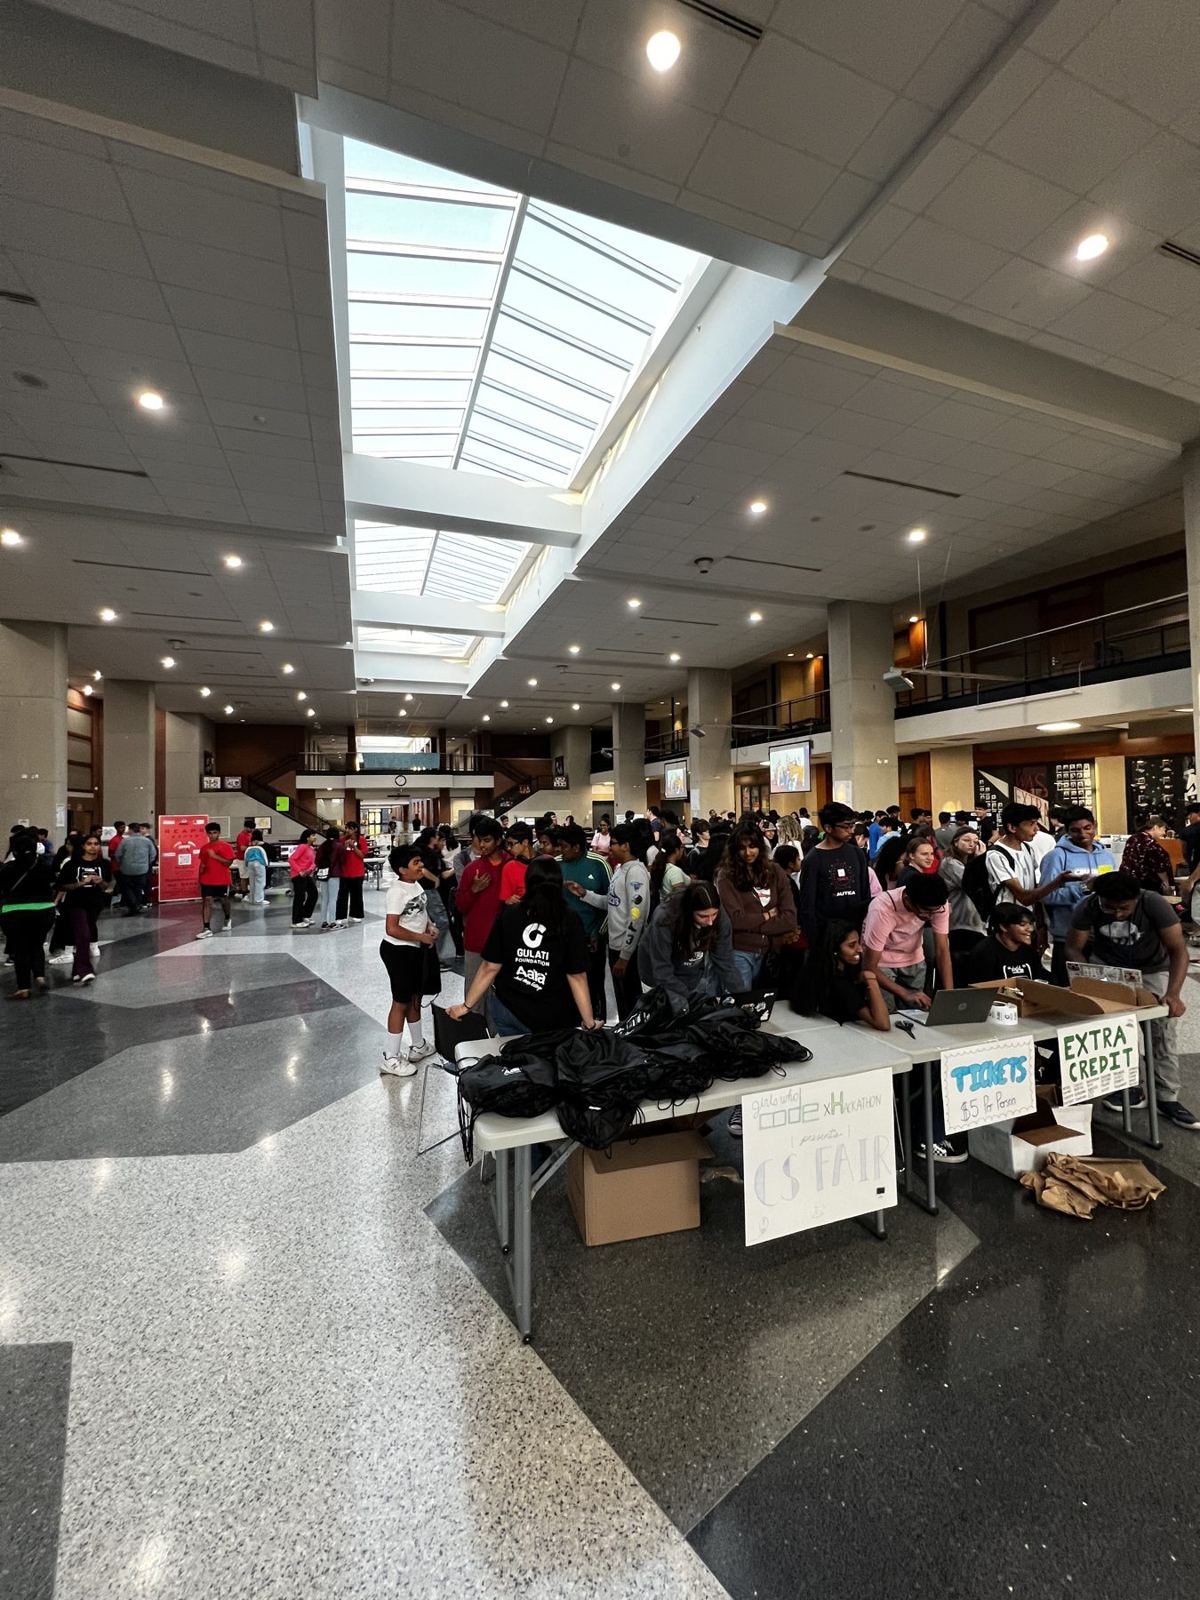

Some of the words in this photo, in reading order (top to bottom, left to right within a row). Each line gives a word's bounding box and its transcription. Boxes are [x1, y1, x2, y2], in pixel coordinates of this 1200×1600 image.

[515, 957, 550, 967] FOUNDATION
[516, 948, 549, 960] GULATI
[1063, 1025, 1127, 1061] EXTRA
[950, 1055, 1027, 1093] TICKETS
[1069, 1047, 1133, 1082] CREDIT
[752, 1095, 778, 1119] girls
[779, 1089, 800, 1104] who
[759, 1088, 820, 1130] code
[960, 1098, 979, 1122] $5
[754, 1152, 800, 1207] CS
[815, 1135, 893, 1192] FAIR
